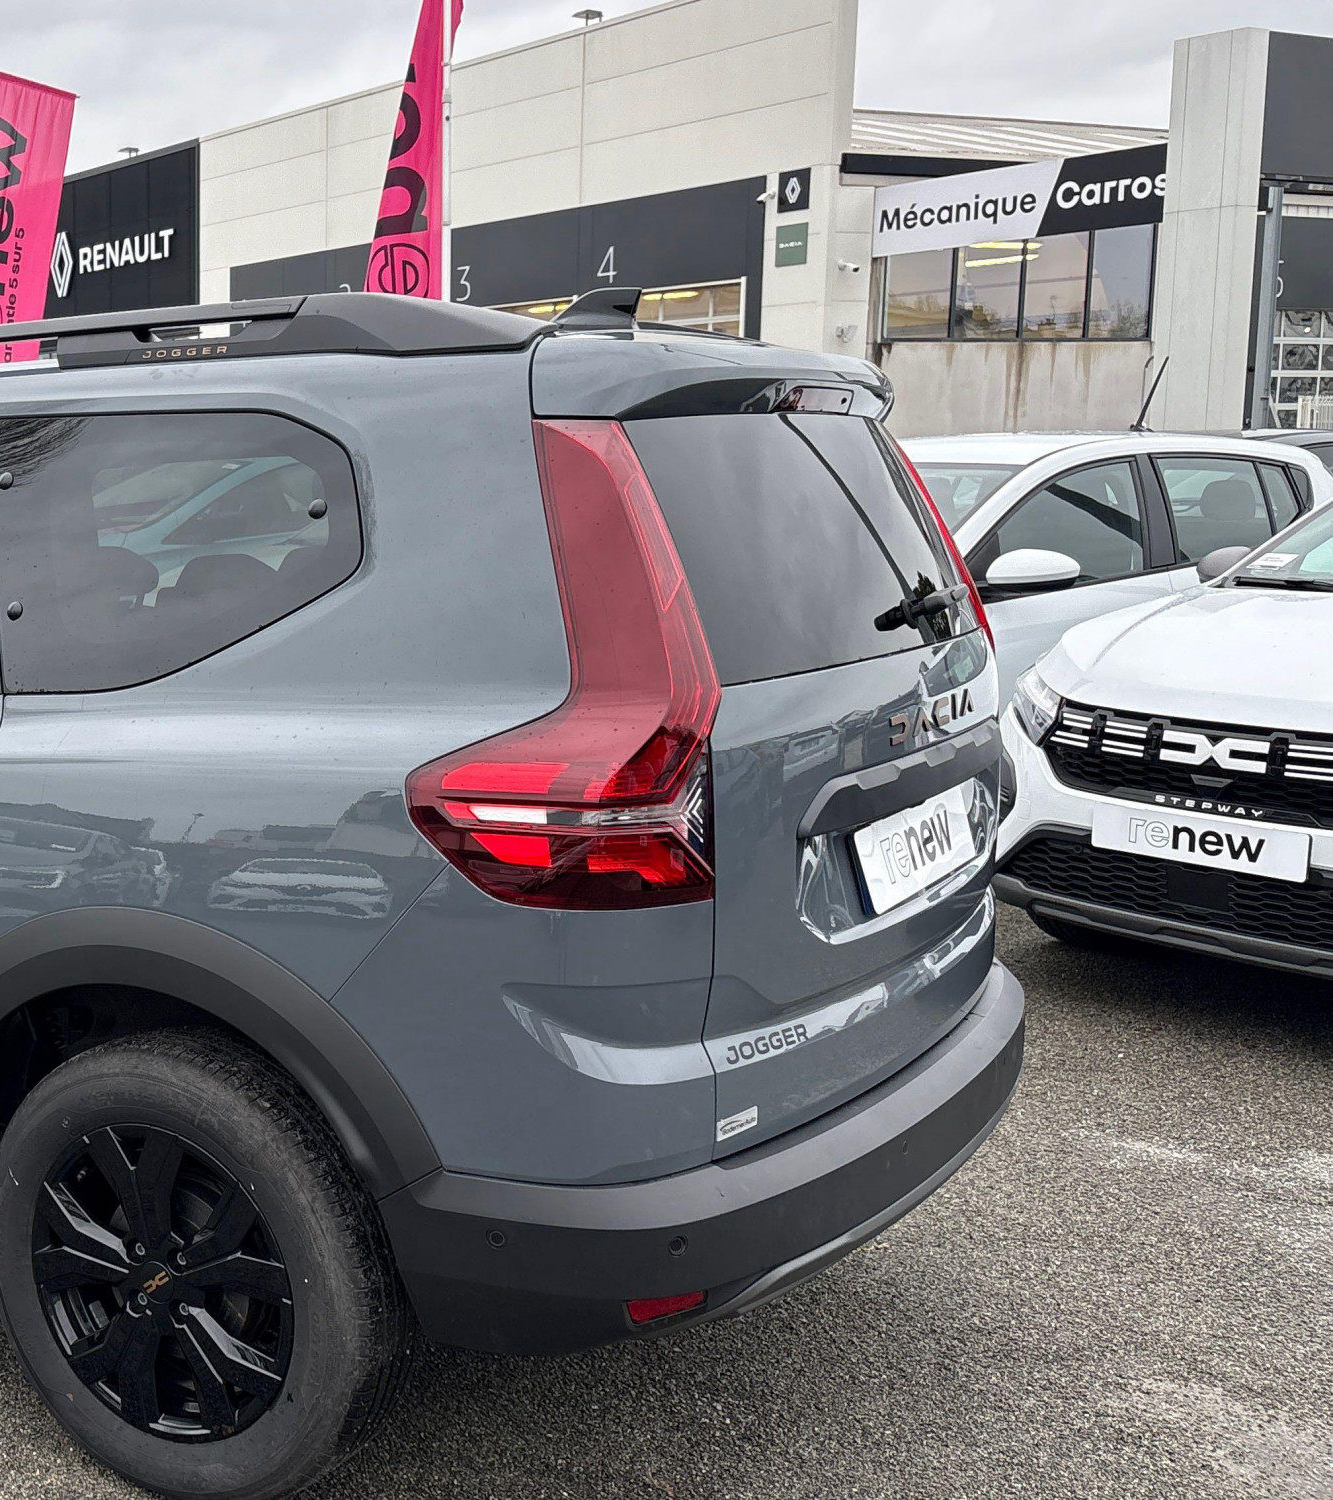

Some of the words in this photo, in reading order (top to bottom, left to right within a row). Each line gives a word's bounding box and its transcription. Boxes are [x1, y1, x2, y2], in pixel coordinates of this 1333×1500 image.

[879, 192, 1037, 233] Mécanique
[15, 227, 25, 239] 5
[78, 228, 174, 275] RENAULT
[12, 242, 24, 274] sur
[597, 246, 617, 284] 4
[9, 278, 18, 289] 5
[455, 265, 471, 302] 3
[142, 346, 228, 359] JOGGER
[889, 688, 974, 746] DACIA
[1154, 794, 1264, 818] STEPWAY
[879, 809, 952, 884] renew
[1127, 816, 1266, 863] renew
[726, 1023, 808, 1064] JOGGER
